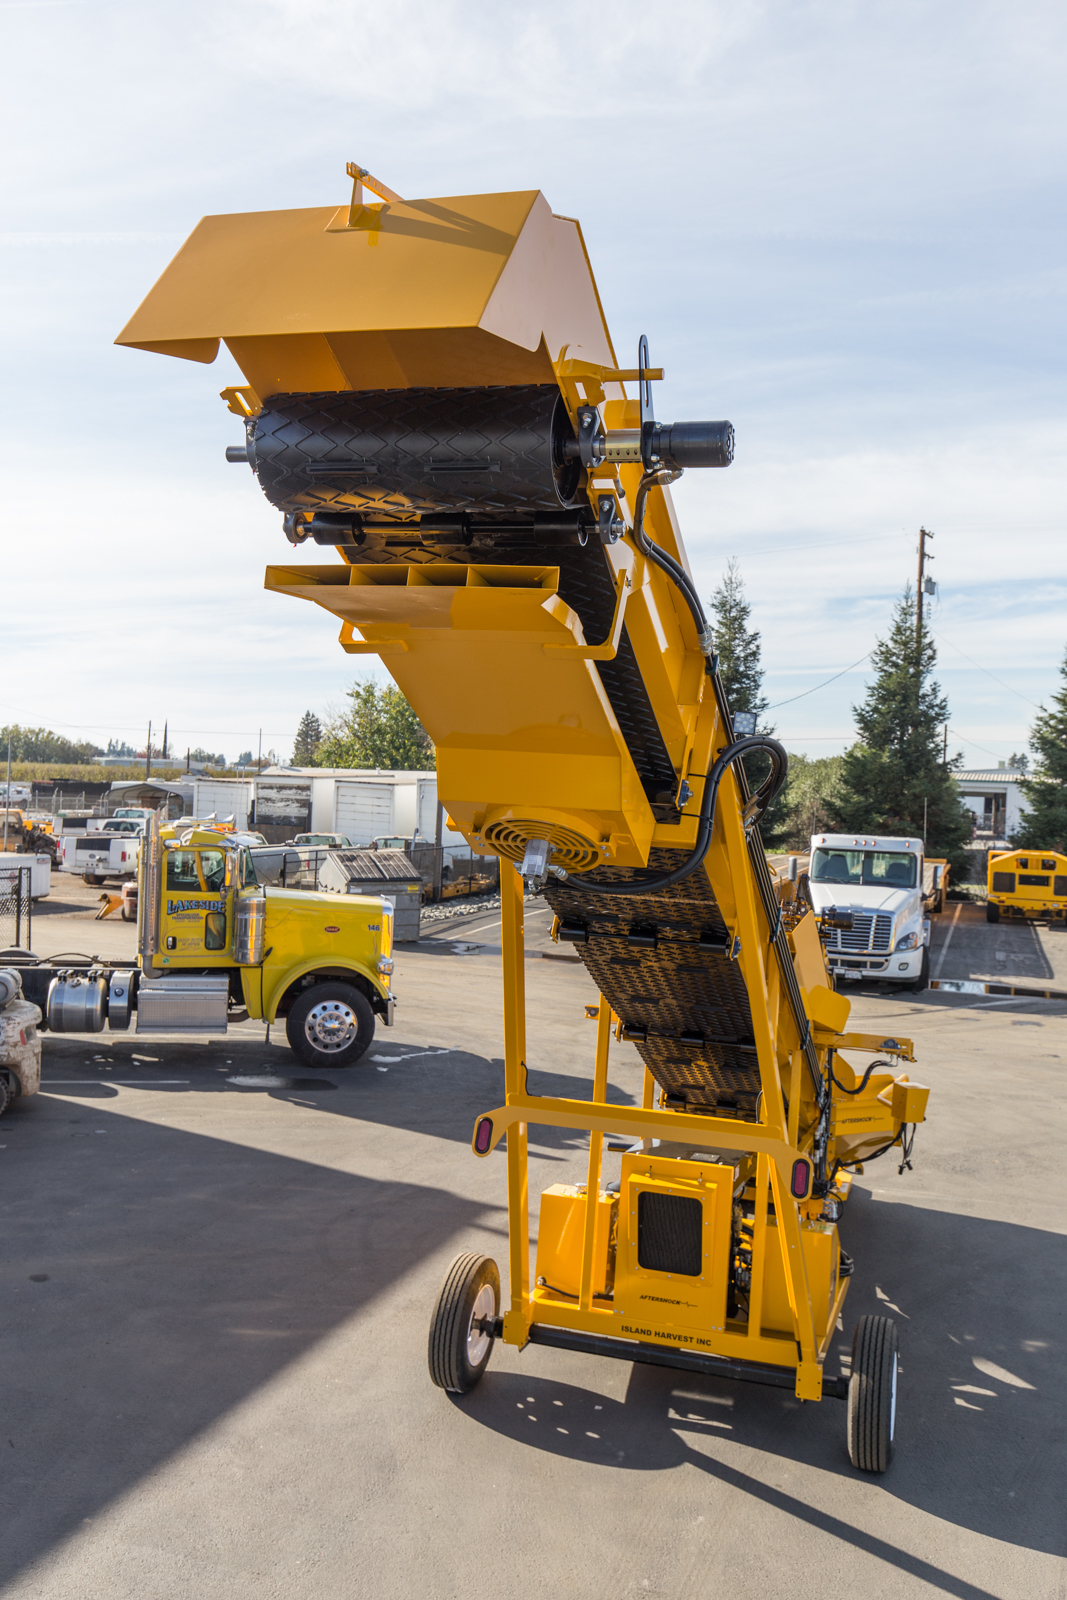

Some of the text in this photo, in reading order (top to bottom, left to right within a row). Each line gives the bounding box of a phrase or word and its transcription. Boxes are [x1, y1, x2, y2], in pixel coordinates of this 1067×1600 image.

[167, 900, 226, 915] LAKESIDE
[367, 924, 380, 932] 146
[639, 1294, 681, 1306] AFTERSHOCK
[621, 1325, 712, 1347] ISLAND HARVEST INC
